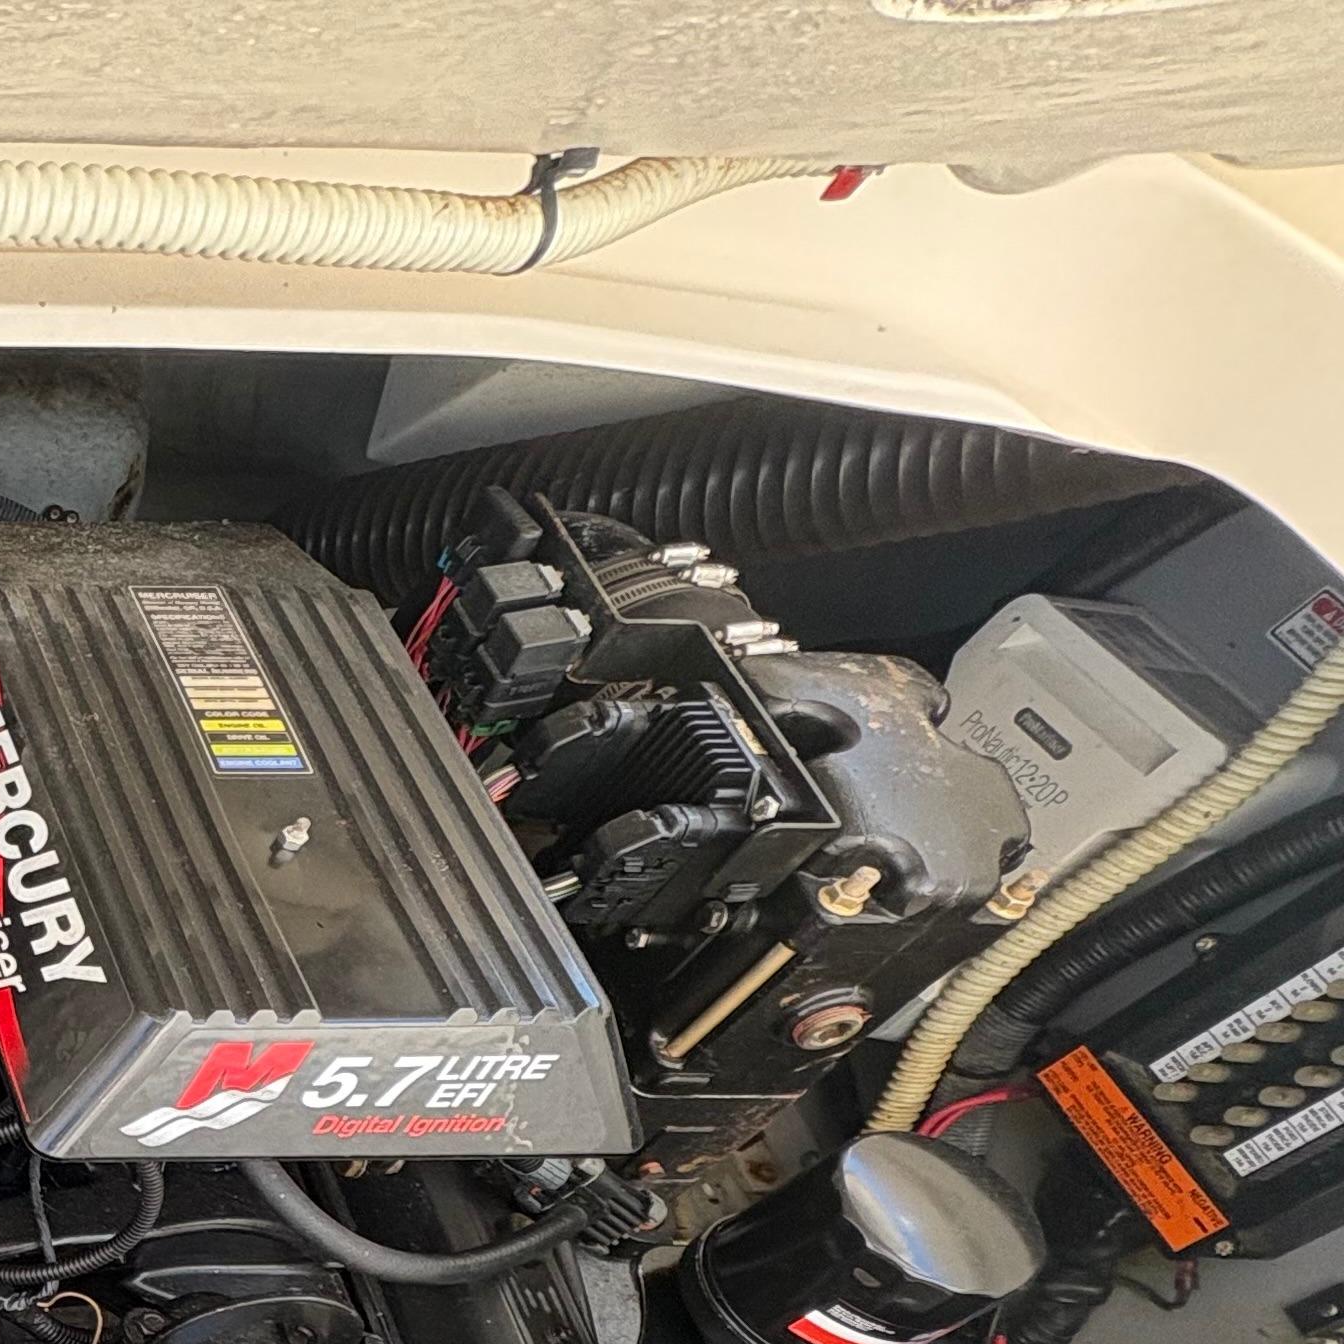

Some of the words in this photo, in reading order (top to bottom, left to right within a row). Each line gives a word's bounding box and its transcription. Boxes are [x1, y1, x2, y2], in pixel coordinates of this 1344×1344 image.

[301, 1056, 440, 1108] 5.7
[436, 1055, 559, 1081] LITRE
[426, 1082, 495, 1108] EFI
[312, 1115, 403, 1138] Digital
[408, 1114, 506, 1137] Ignition
[1126, 1115, 1173, 1165] WARNING
[1189, 1189, 1225, 1228] NEGATIVE
